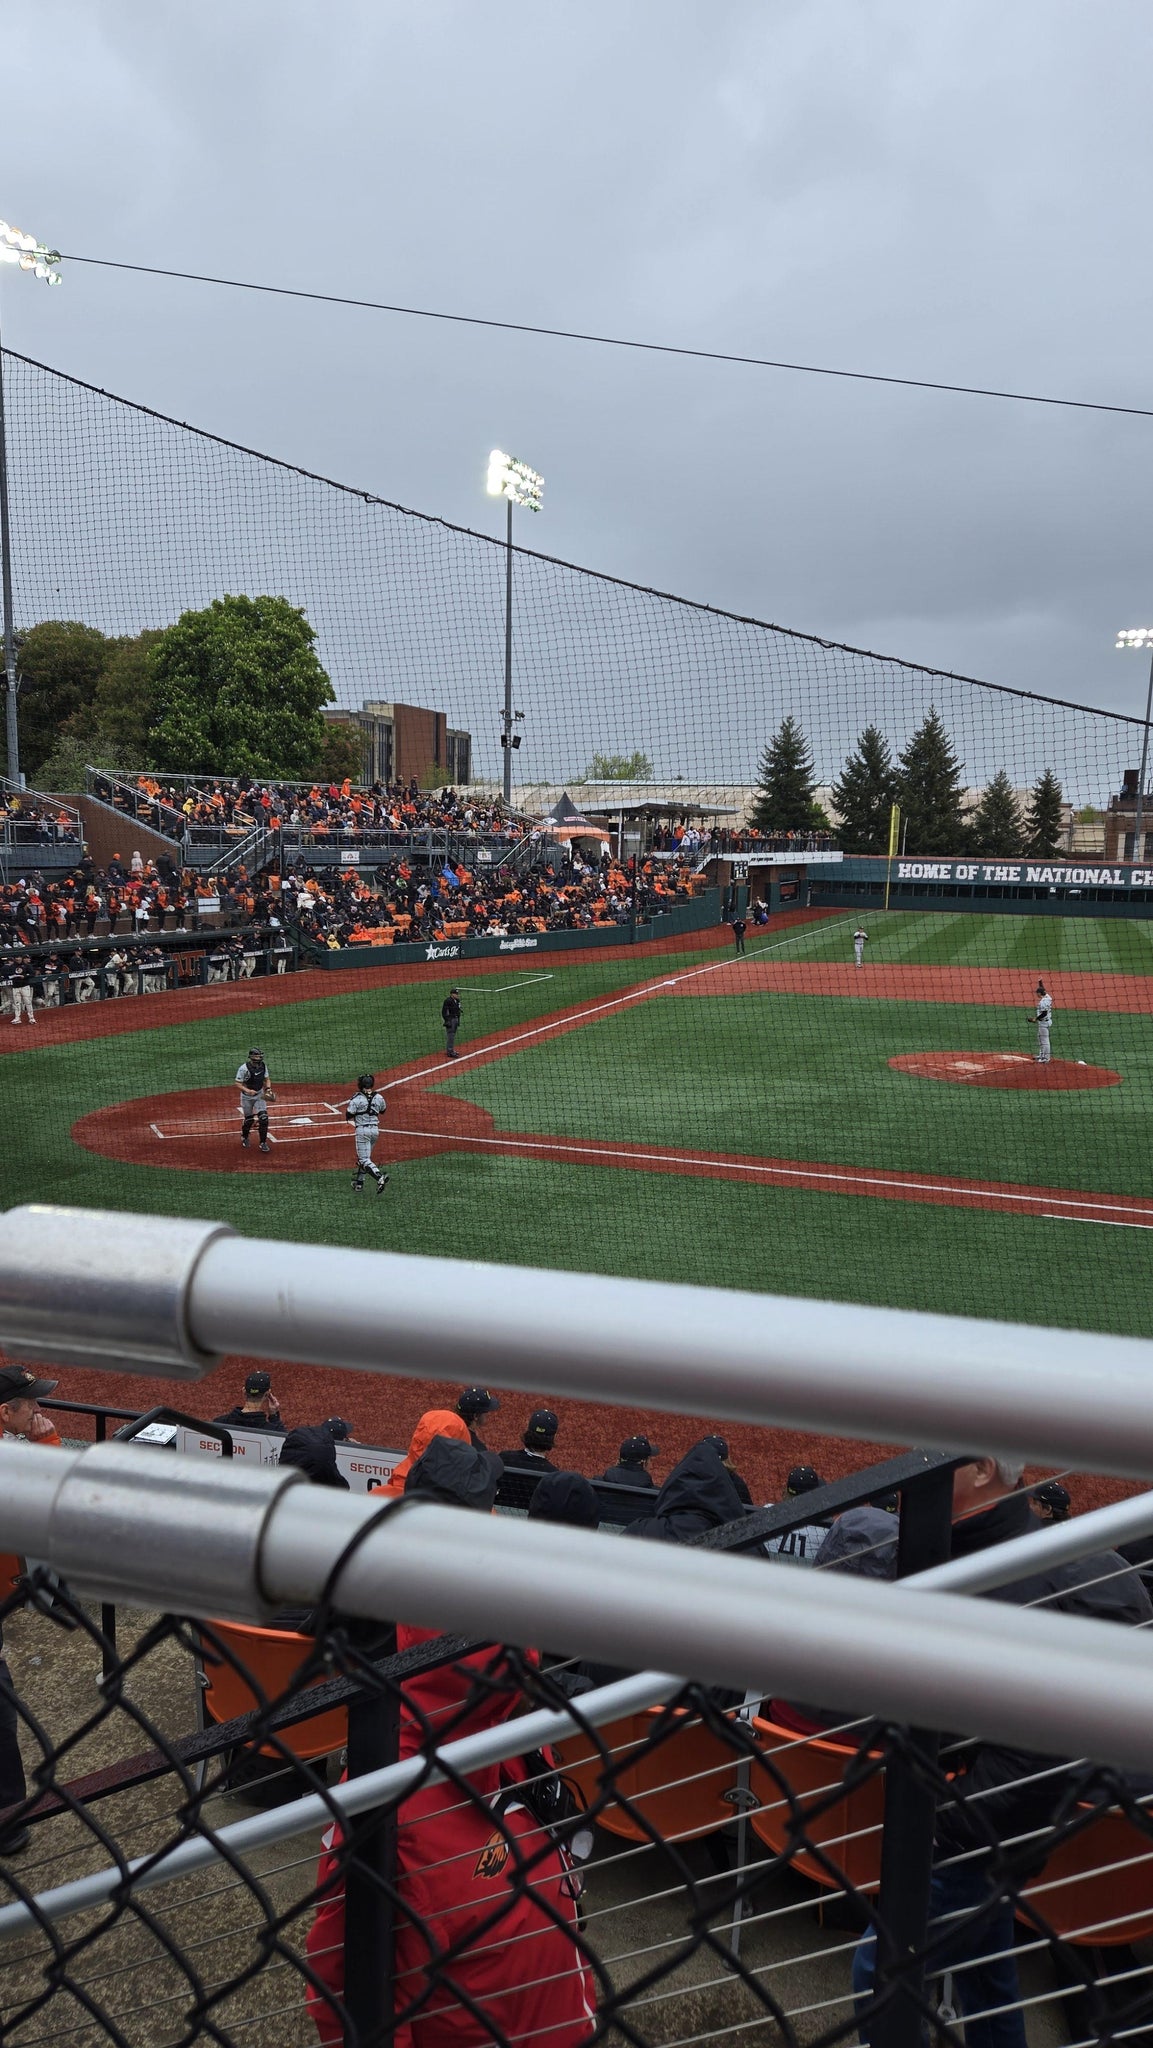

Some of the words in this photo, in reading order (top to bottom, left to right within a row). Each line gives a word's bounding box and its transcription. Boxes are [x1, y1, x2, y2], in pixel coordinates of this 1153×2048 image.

[898, 863, 951, 880] HOME
[955, 865, 979, 881] OF
[983, 865, 1021, 882] THE
[1026, 866, 1125, 885] NATIONAL
[199, 1440, 246, 1455] SECON
